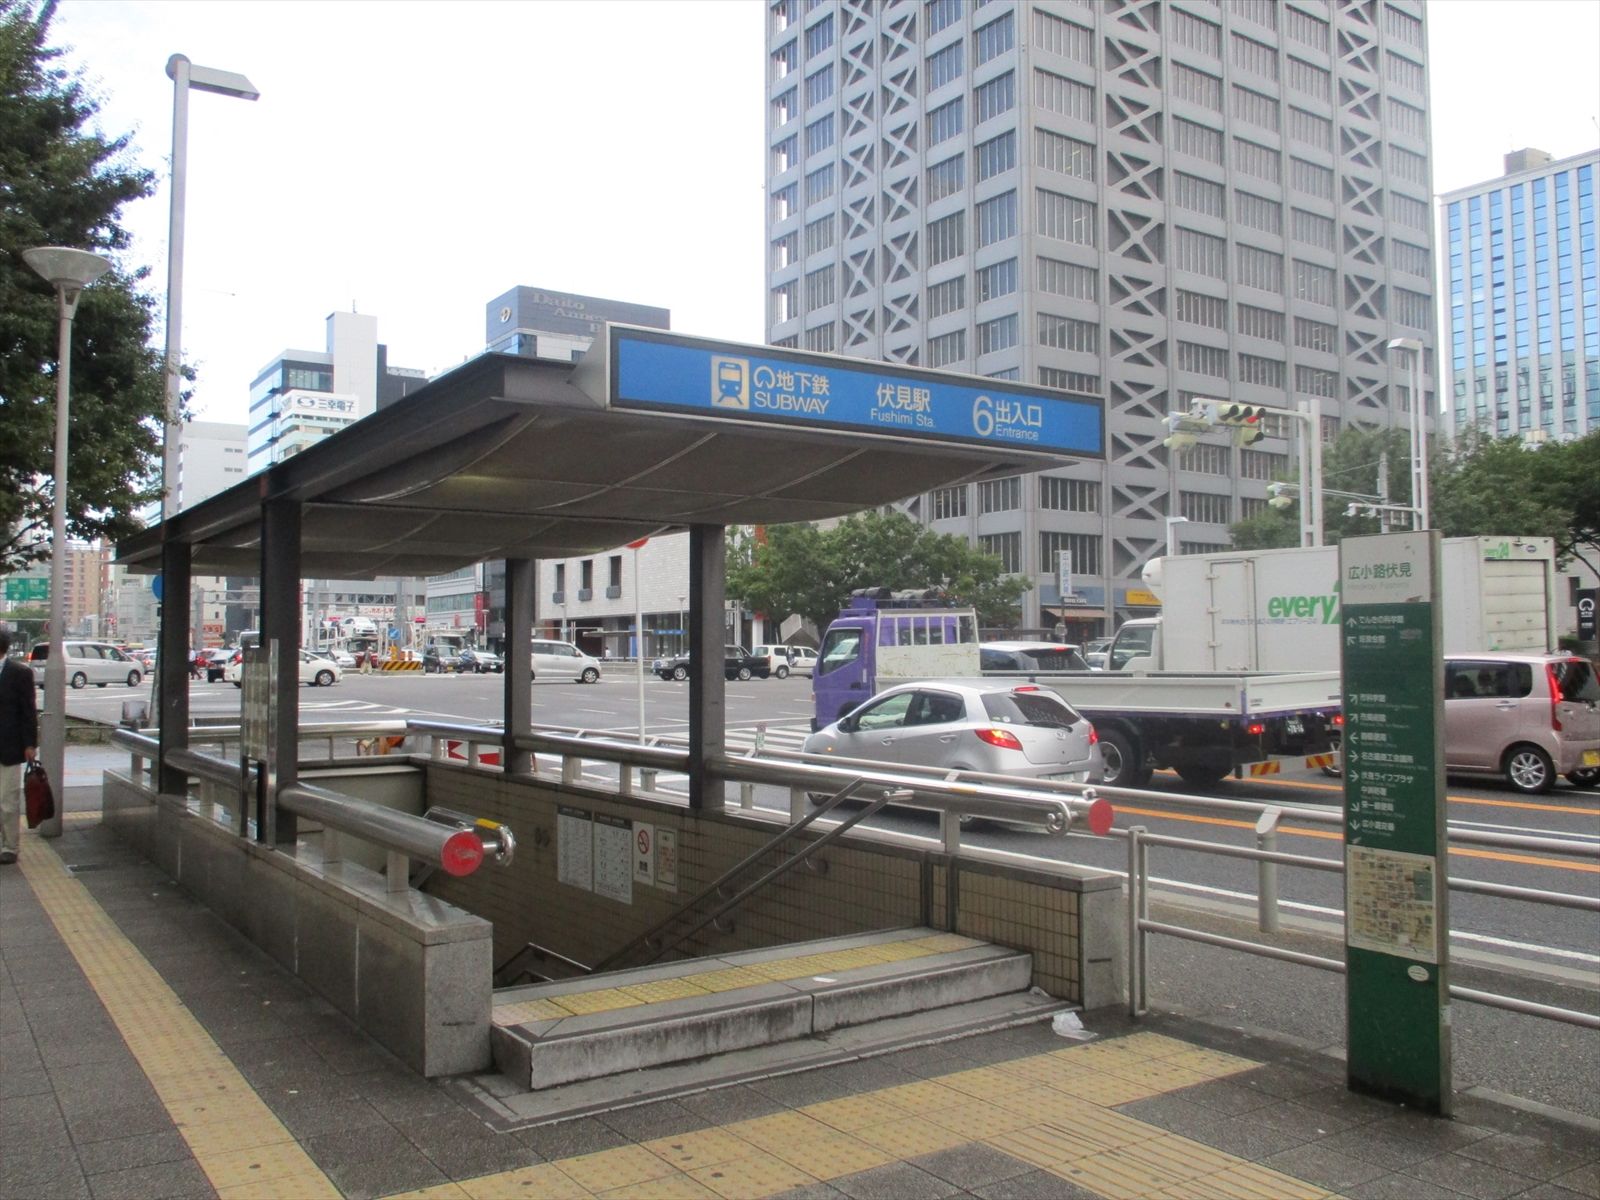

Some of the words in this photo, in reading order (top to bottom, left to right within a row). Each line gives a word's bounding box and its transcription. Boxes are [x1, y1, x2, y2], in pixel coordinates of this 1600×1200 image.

[754, 391, 830, 415] SUBWAY
[876, 383, 931, 413] 伏見駅
[870, 408, 913, 425] Fushimi
[916, 413, 937, 428] Sta.
[972, 395, 994, 437] 6
[995, 399, 1042, 428] 出入口
[996, 424, 1040, 441] Entrance
[1348, 562, 1412, 580] 広小路伏見
